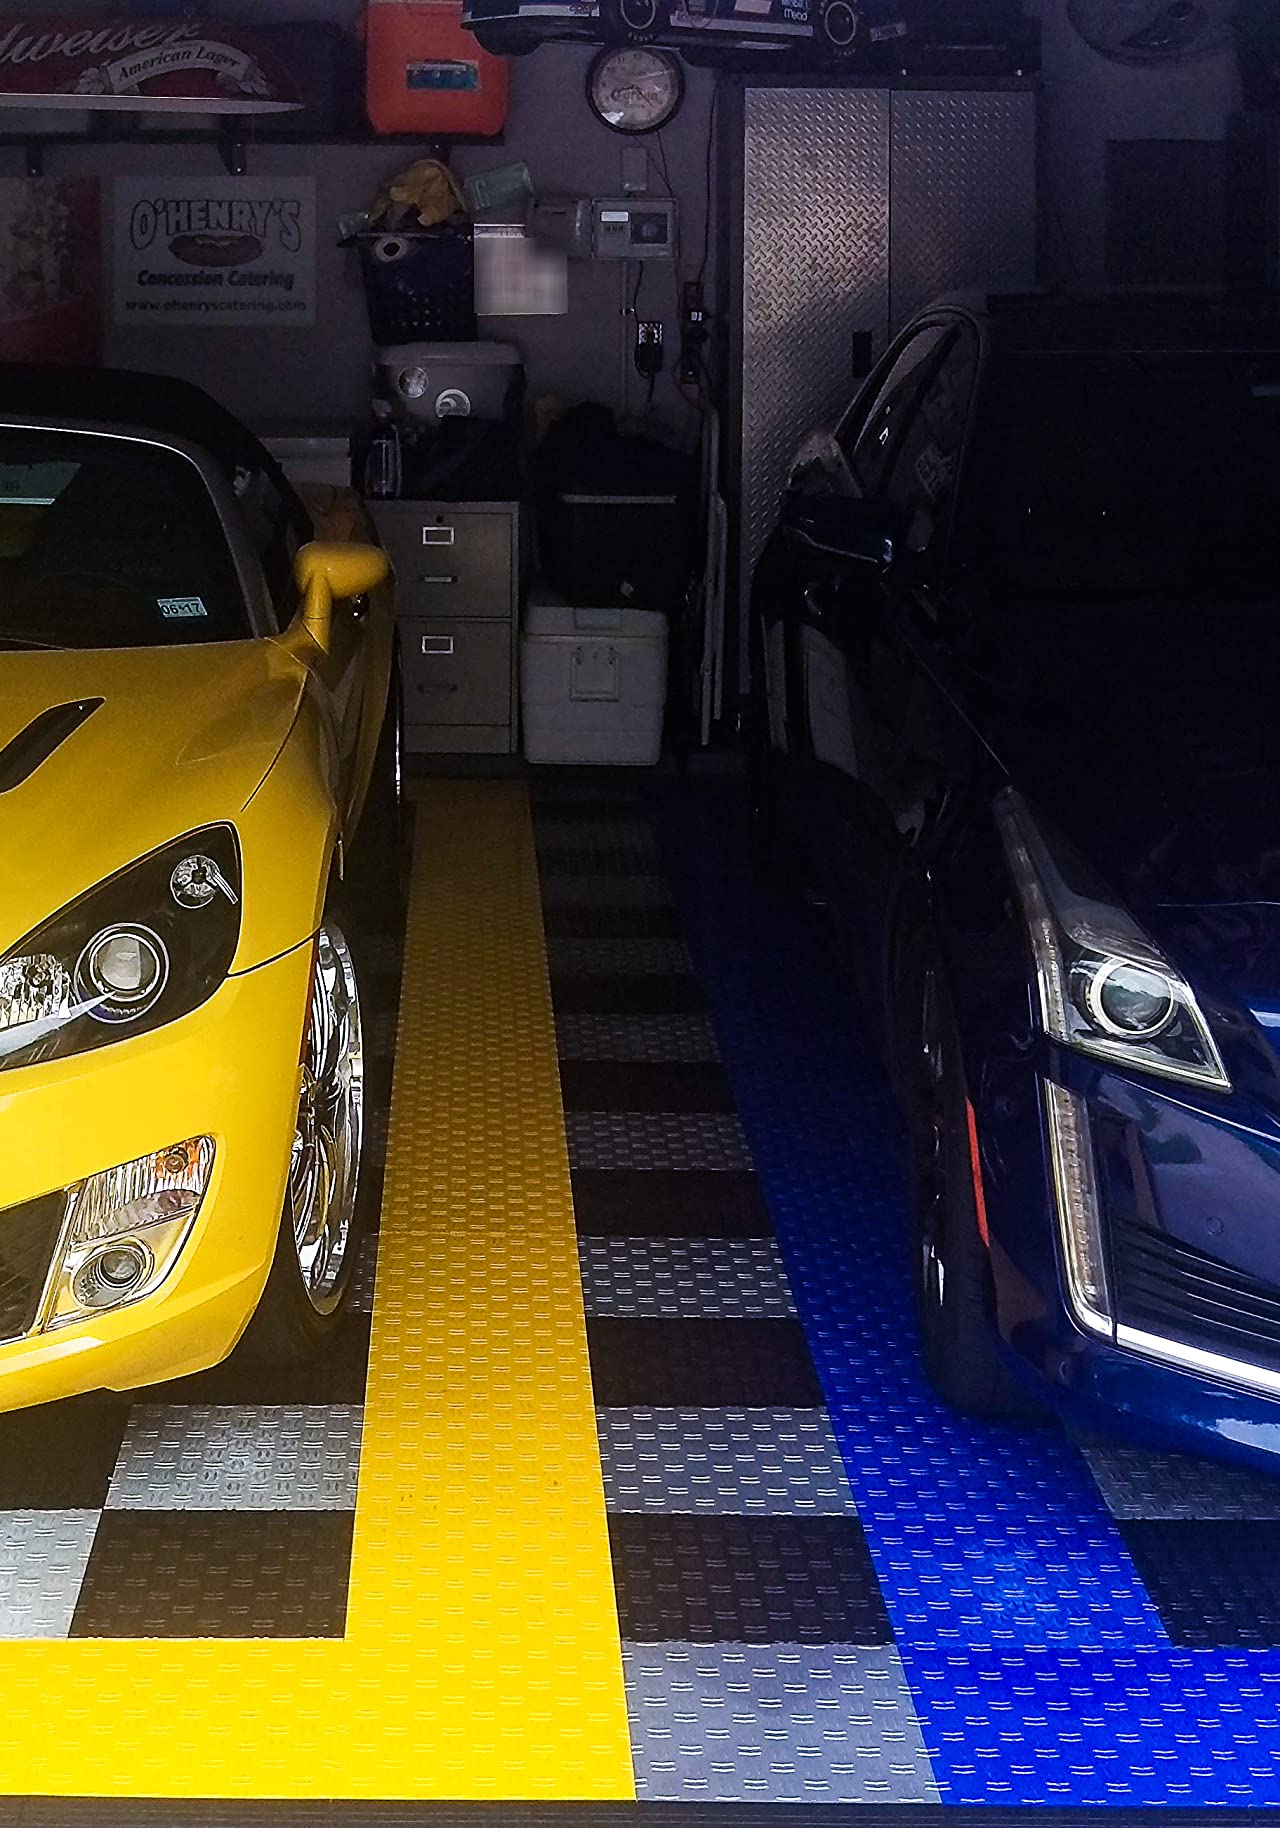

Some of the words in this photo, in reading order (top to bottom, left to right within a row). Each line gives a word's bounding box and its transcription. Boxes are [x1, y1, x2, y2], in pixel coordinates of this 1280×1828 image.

[119, 49, 192, 80] American
[196, 46, 241, 67] Lager
[130, 198, 301, 252] O'HENRY'S
[137, 270, 223, 286] Concession
[228, 270, 295, 290] Catering
[125, 299, 307, 312] www.ohenryscatering.com
